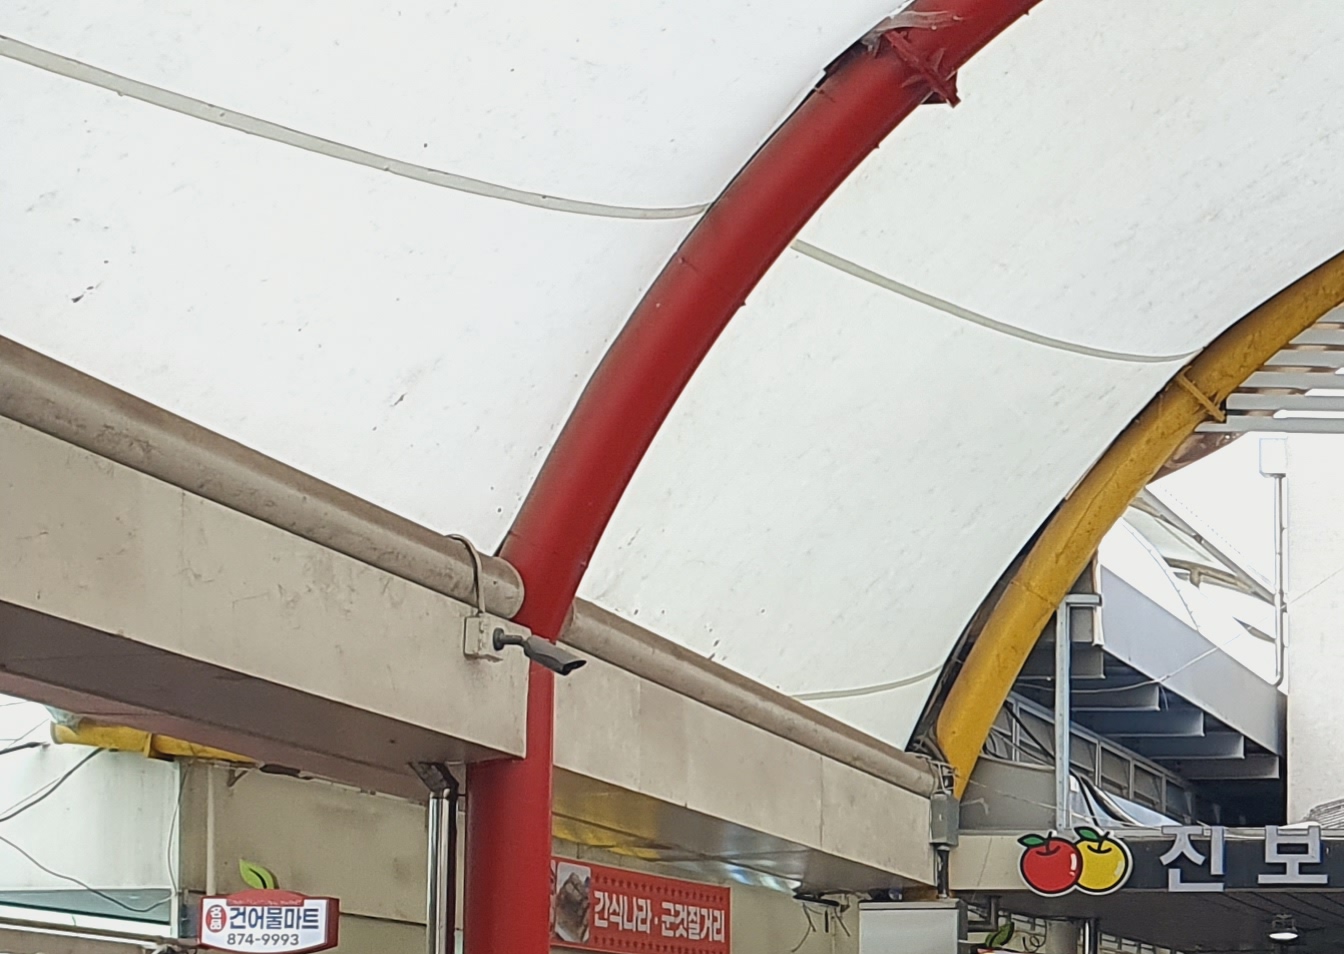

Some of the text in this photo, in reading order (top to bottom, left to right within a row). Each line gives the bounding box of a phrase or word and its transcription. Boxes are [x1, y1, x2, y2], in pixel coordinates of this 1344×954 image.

[230, 906, 319, 930] 건어물마트
[594, 890, 725, 944] 간식나라 군것질거리
[227, 933, 299, 946] 874-9993
